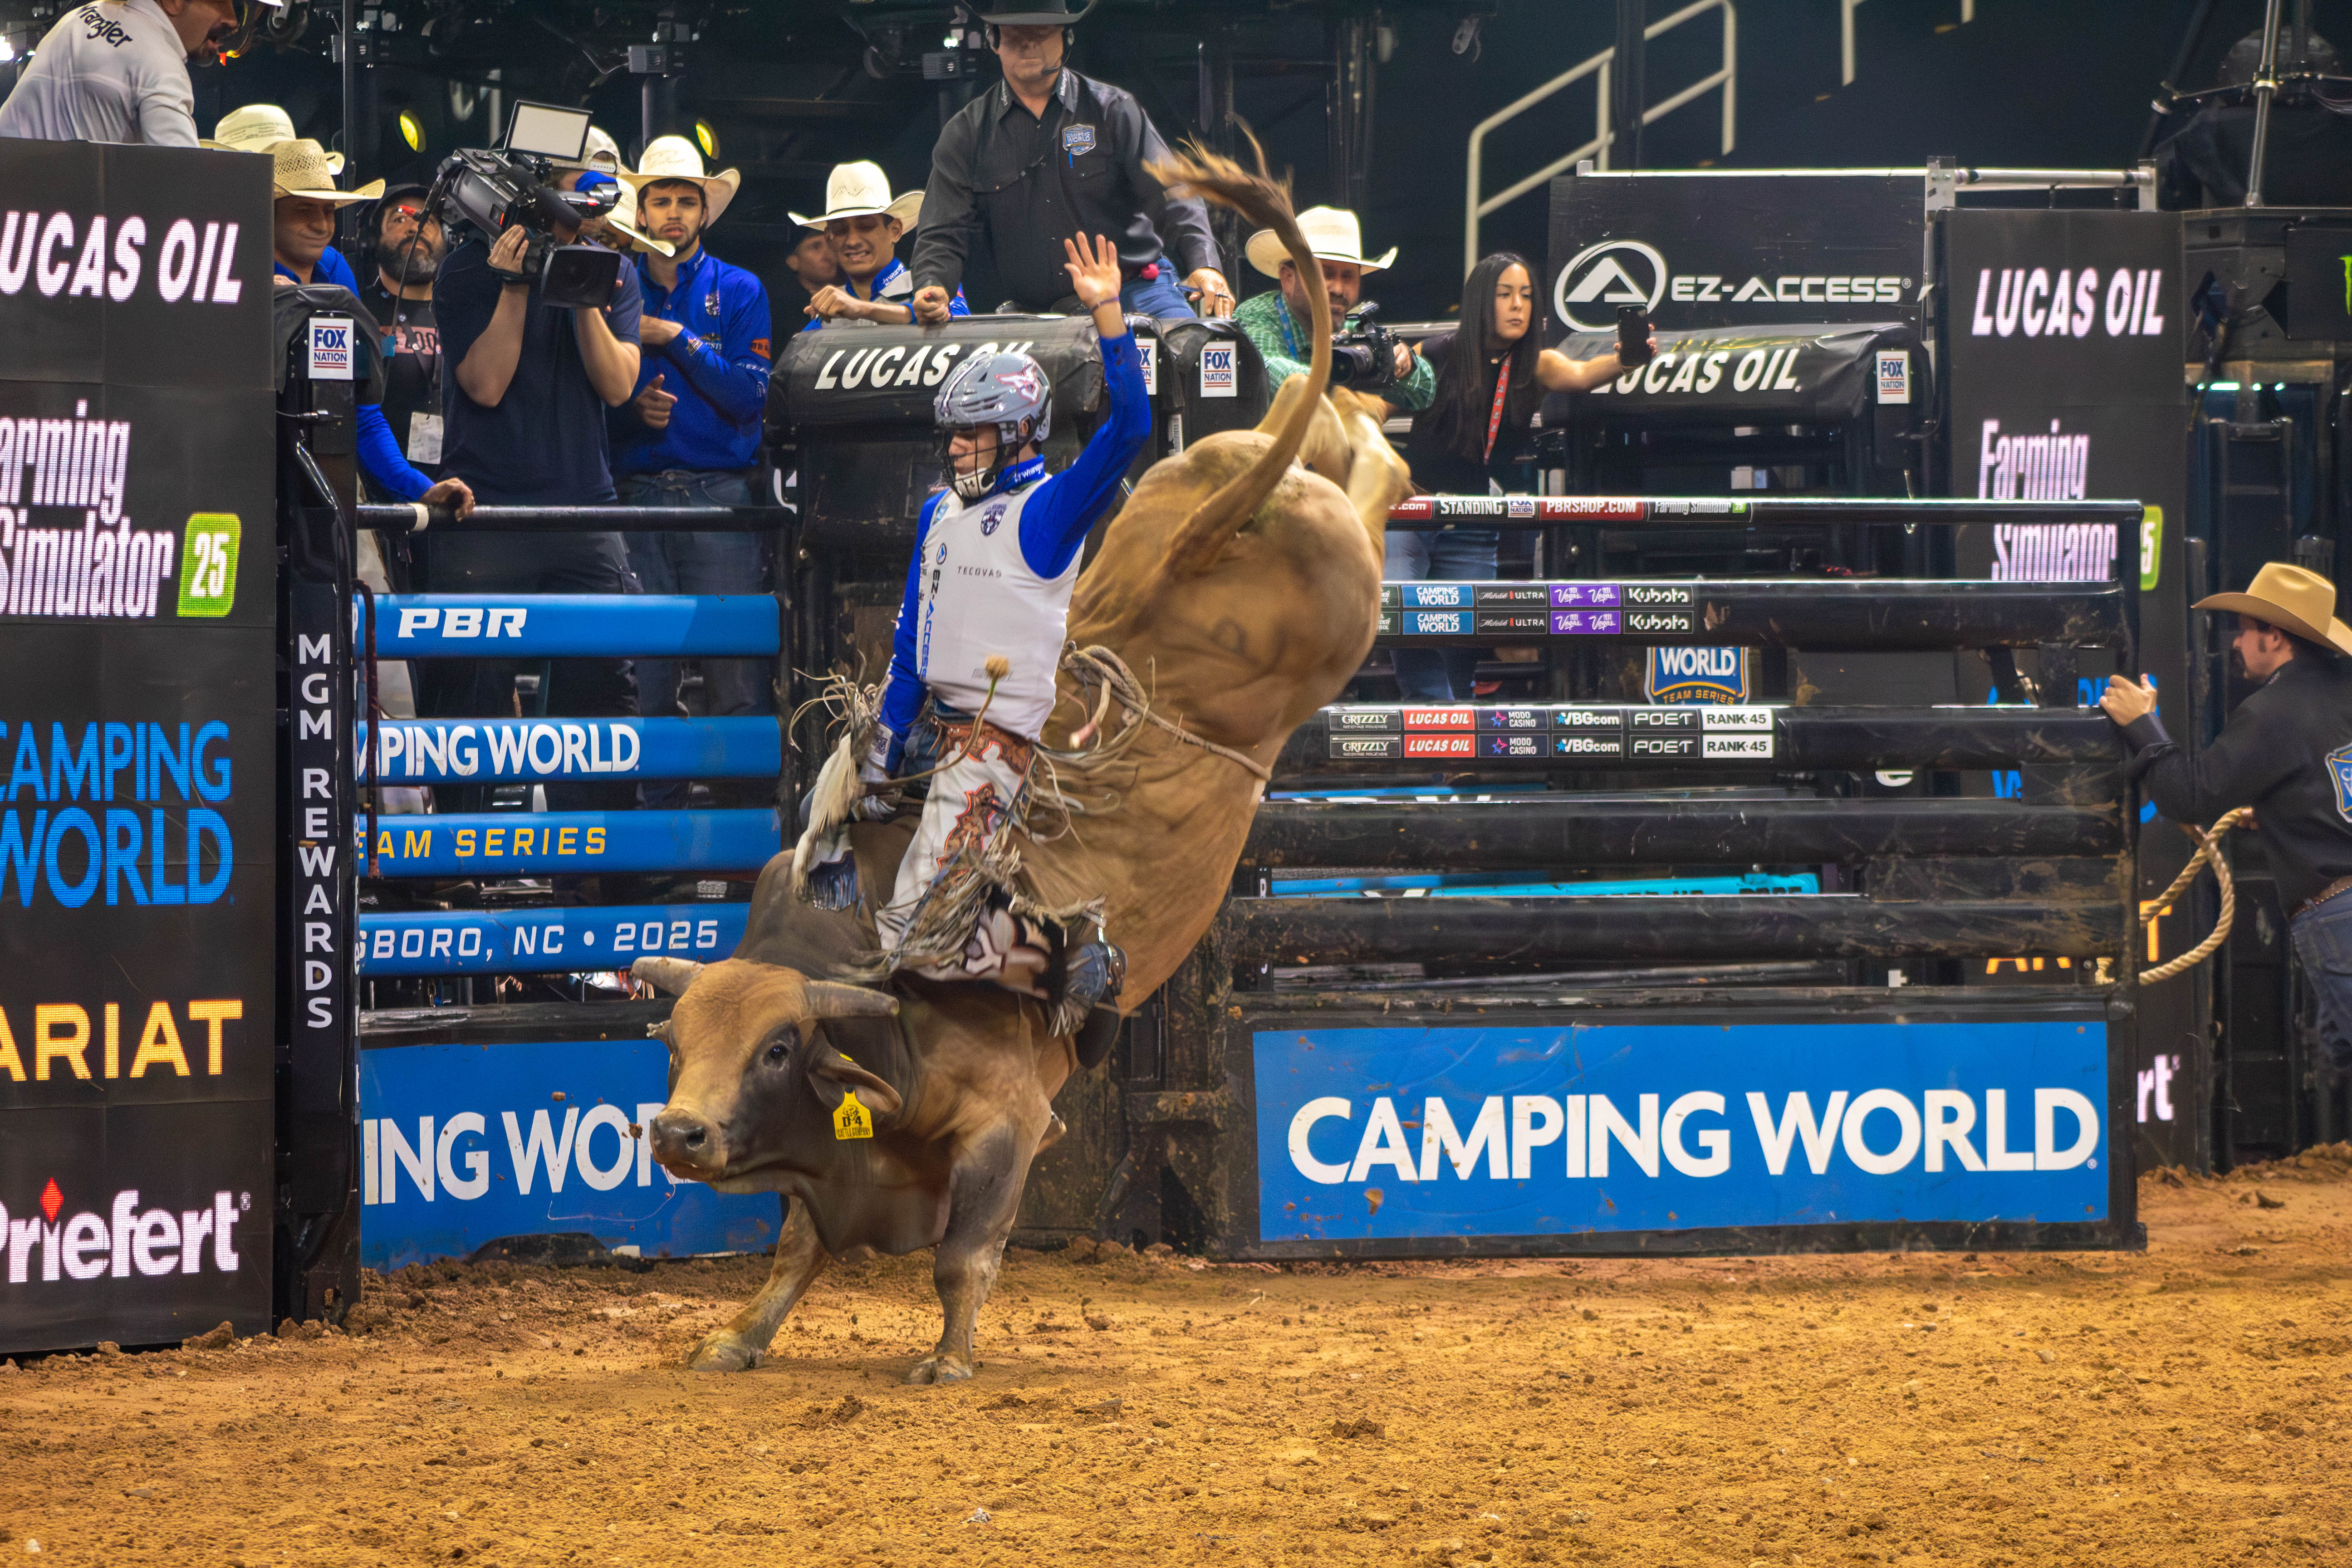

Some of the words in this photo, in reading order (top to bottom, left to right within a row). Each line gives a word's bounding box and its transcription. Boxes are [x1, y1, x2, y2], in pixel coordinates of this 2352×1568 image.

[76, 4, 133, 48] Wrangler
[158, 218, 242, 304] OIL
[1671, 276, 1901, 302] EZ-ACCESS
[1972, 268, 2098, 338] LUCAS
[2105, 268, 2164, 337] OIL
[314, 328, 347, 349] FOX
[314, 352, 347, 363] NATION
[1205, 352, 1231, 369] FOX
[815, 343, 962, 390] LUCAS
[1733, 348, 1801, 392] OIL
[1881, 361, 1904, 377] FOX
[1205, 373, 1232, 382] NATION
[1881, 381, 1904, 389] NATION
[1979, 418, 2090, 500] Farming
[1441, 500, 1503, 514] STANDING
[1546, 501, 1636, 514] PBRSHOP.COM
[1655, 501, 1689, 515] Farming
[1690, 501, 1731, 514] Simulator
[1991, 523, 2118, 581] Simulator
[2141, 522, 2156, 574] 5
[190, 533, 230, 598] 25
[958, 566, 1002, 578] TECOVAS
[1416, 587, 1458, 596] CAMPING
[1478, 592, 1508, 600] Michelob
[1515, 591, 1544, 599] ULTRA
[1628, 588, 1688, 603] Kubota
[1418, 595, 1460, 605] WORLD
[397, 608, 527, 638] PBR
[1417, 614, 1459, 622] CAMPING
[1479, 618, 1509, 627] Michelob
[1515, 618, 1545, 627] ULTRA
[1629, 615, 1688, 630] Kubota
[1417, 622, 1460, 632] WORLD
[1659, 647, 1736, 676] WORLD
[299, 633, 332, 740] MGM
[1663, 690, 1691, 704] TEAM
[1695, 689, 1735, 705] SERIES
[1342, 715, 1388, 725] GRIZZLY
[1408, 714, 1448, 725] LUCAS
[1450, 714, 1470, 725] OIL
[1508, 711, 1531, 719] MODO
[1634, 713, 1695, 725] POET
[1509, 719, 1536, 727] CASINO
[483, 723, 641, 774] WORLD
[1342, 742, 1389, 753] GRIZZLY
[1409, 740, 1449, 752] LUCAS
[1450, 740, 1470, 752] OIL
[1509, 738, 1532, 746] MODO
[1634, 740, 1695, 753] POET
[1509, 746, 1536, 755] CASINO
[454, 827, 607, 858] SERIES
[0, 807, 233, 908] WORLD
[299, 768, 336, 1029] REWARDS
[514, 925, 565, 956] NC
[613, 920, 719, 952] 2025
[1288, 1090, 1731, 1183] CAMPING
[1746, 1088, 2099, 1175] WORLD
[0, 1177, 240, 1284] riefert
